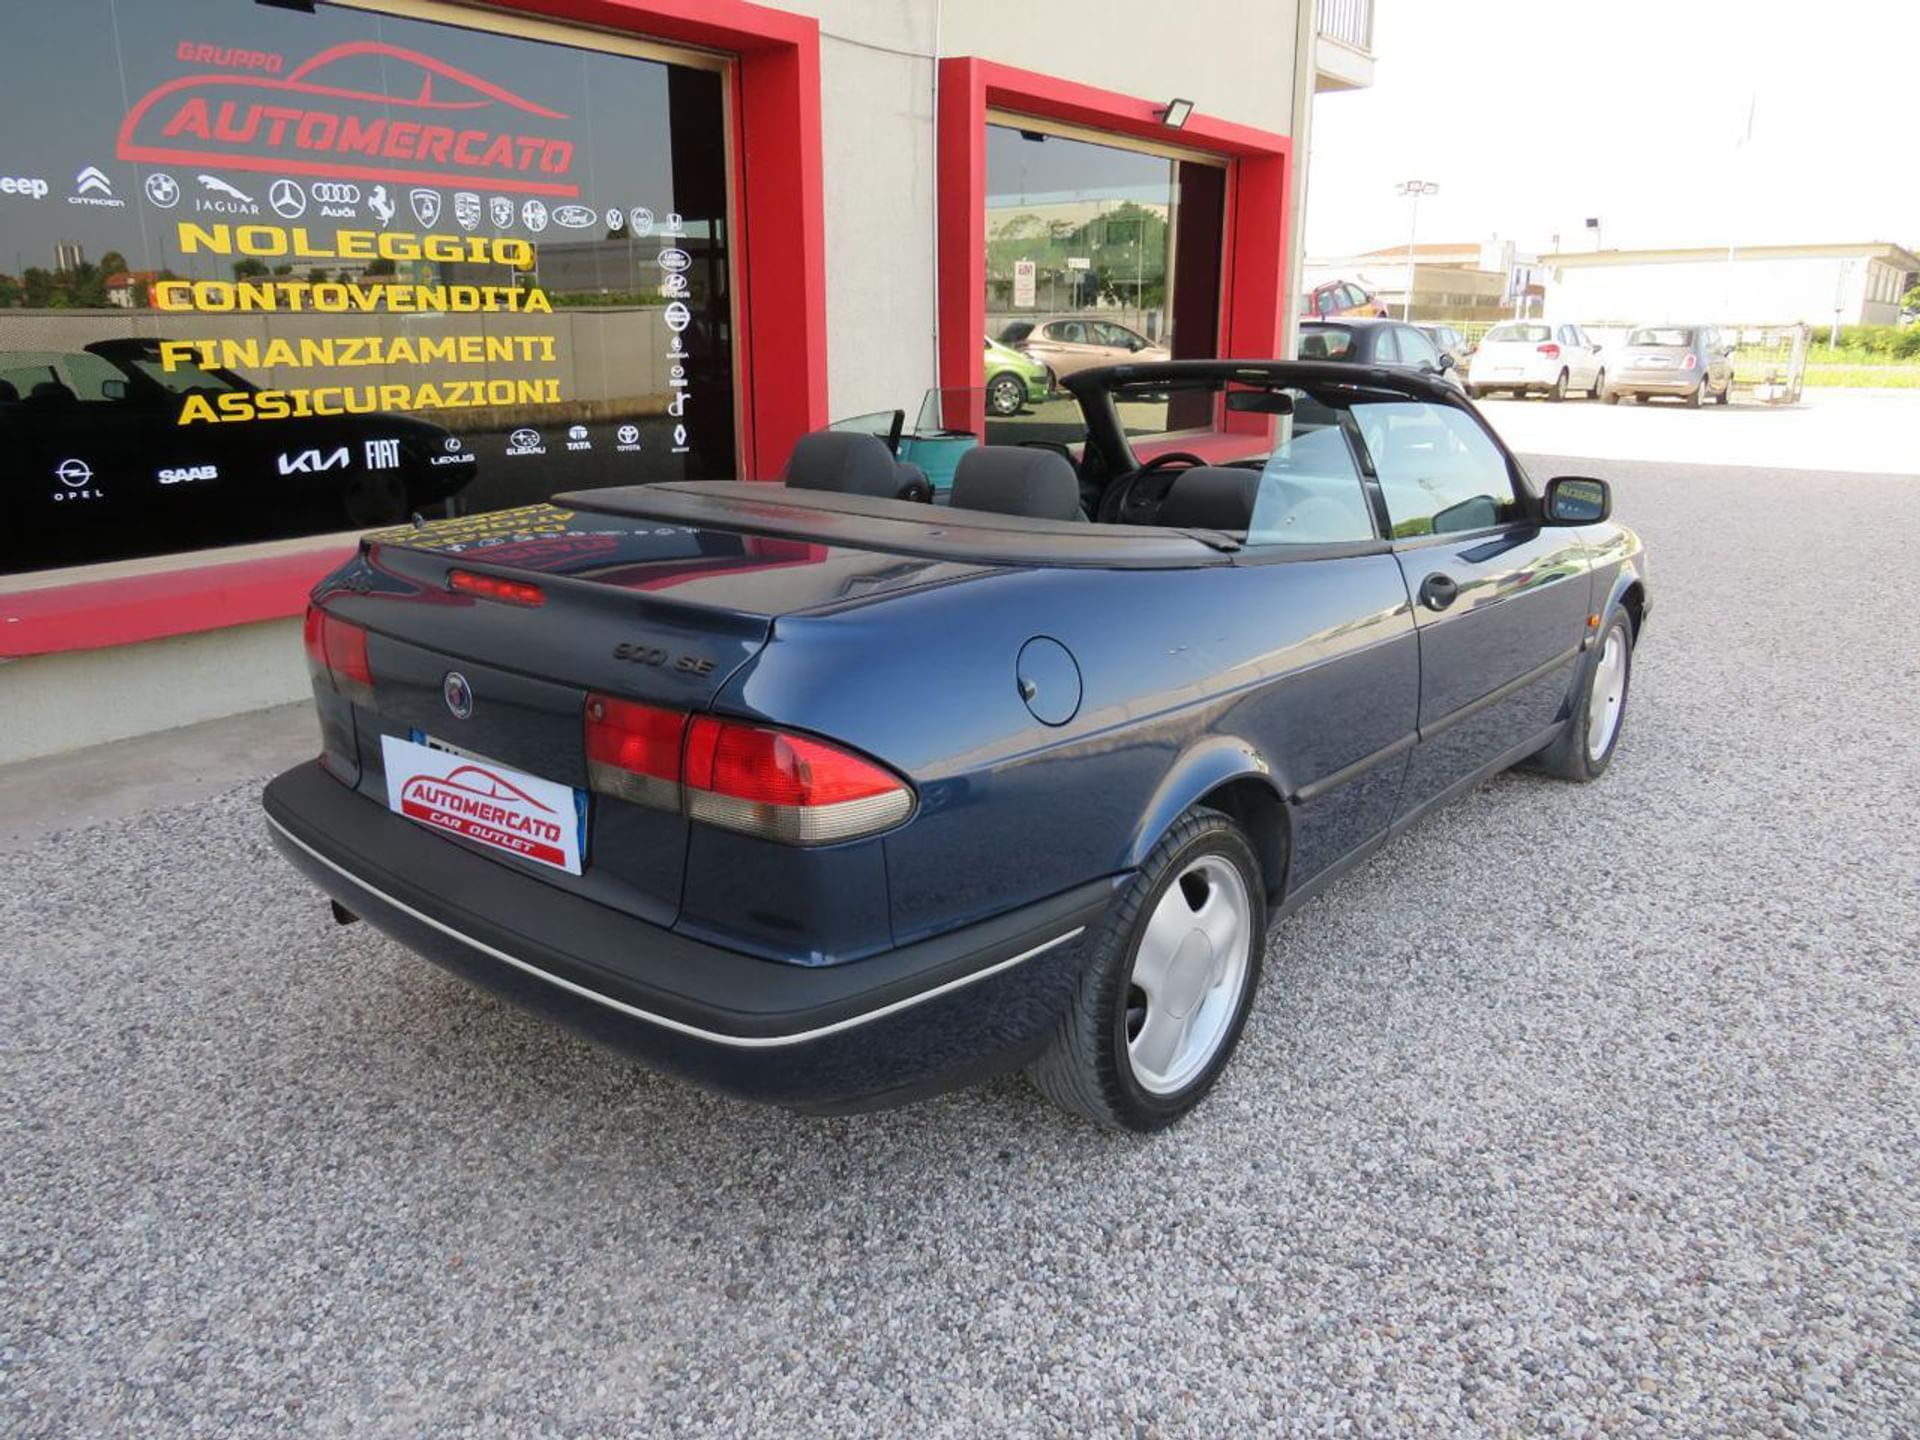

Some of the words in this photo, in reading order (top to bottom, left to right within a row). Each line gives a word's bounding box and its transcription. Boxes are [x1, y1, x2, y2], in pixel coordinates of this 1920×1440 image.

[176, 42, 284, 73] GRUPPO
[162, 97, 575, 174] AUTOMERCATO
[0, 176, 49, 199] eep
[196, 199, 260, 216] JAGUAR
[320, 205, 356, 218] Audi
[177, 222, 535, 266] NOLEGGIO
[154, 280, 553, 314] CONTOVENDITA
[160, 335, 557, 372] FINANZIAMENTI
[177, 379, 561, 426] ASSICURAZIONI
[365, 439, 400, 470] FIAT
[430, 453, 476, 465] LEXUS
[506, 446, 546, 455] SUBARU
[566, 441, 592, 450] TATA
[158, 465, 219, 484] SAAB
[54, 489, 104, 501] OPEL
[673, 655, 719, 679] SE
[411, 783, 561, 843] AUTOMERCATO
[430, 812, 462, 831] CAR
[469, 824, 535, 853] OUTLET
